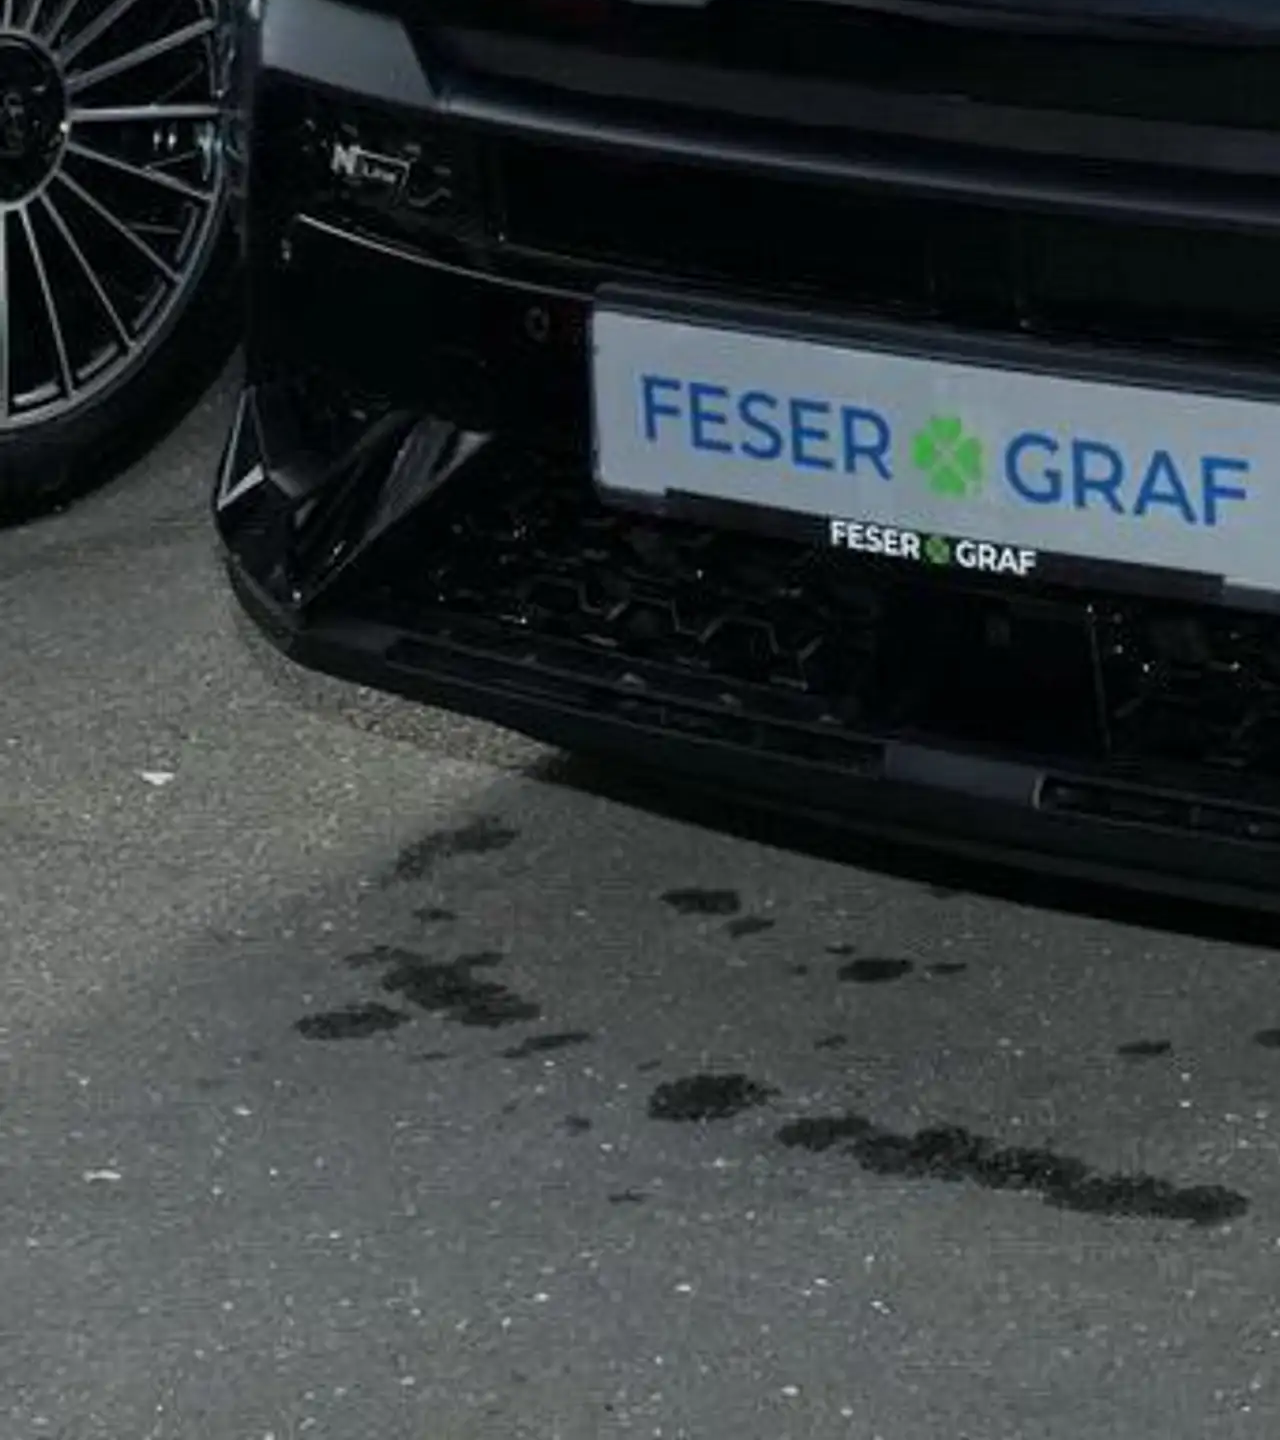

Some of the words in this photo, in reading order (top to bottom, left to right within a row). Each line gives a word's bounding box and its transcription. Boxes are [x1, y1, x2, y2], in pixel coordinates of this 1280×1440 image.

[640, 374, 893, 481] FESER
[1004, 430, 1250, 526] GRAF
[831, 520, 921, 560] FESER
[955, 540, 1037, 576] GRAF
